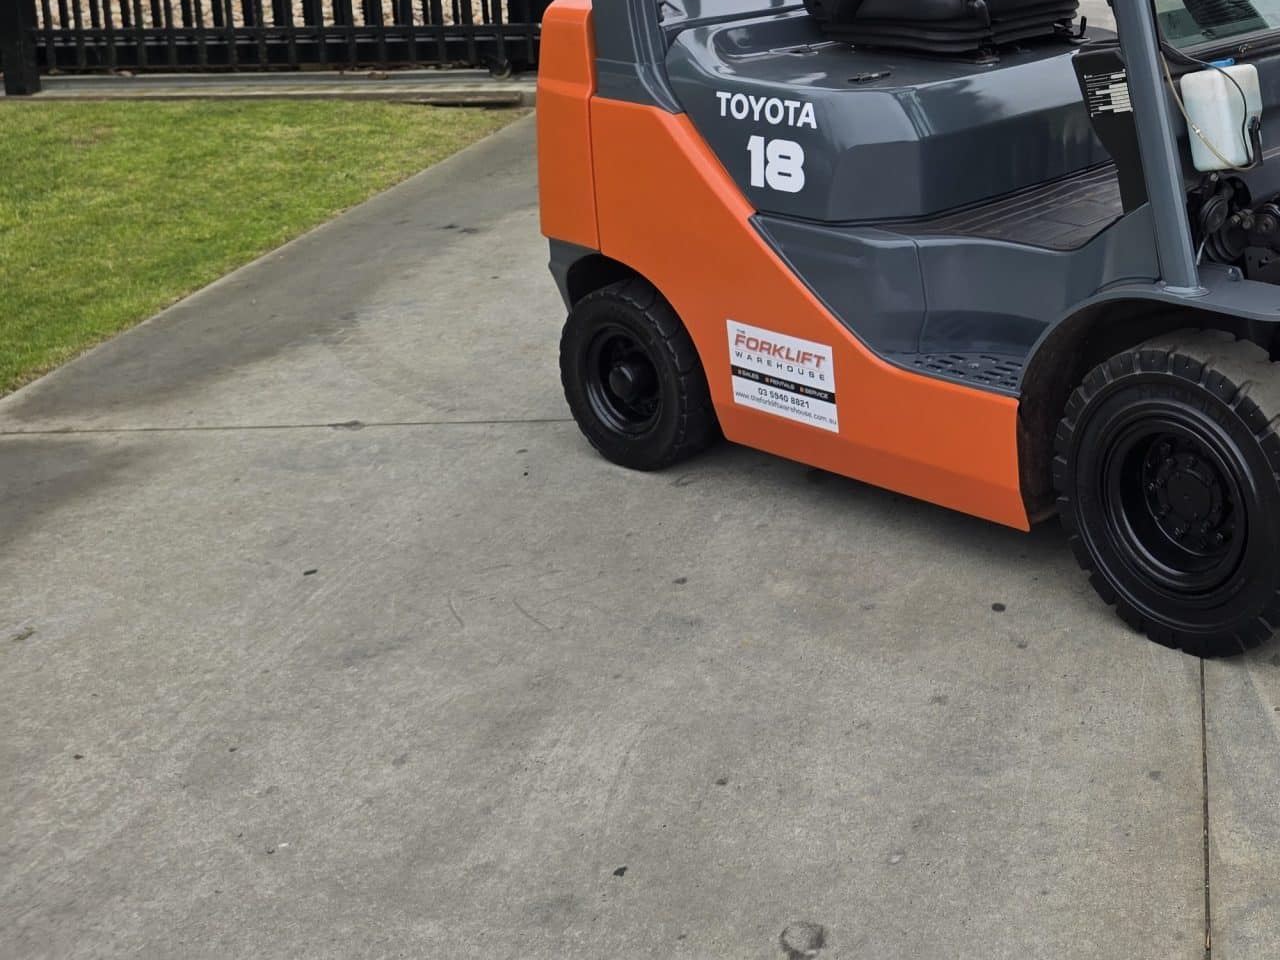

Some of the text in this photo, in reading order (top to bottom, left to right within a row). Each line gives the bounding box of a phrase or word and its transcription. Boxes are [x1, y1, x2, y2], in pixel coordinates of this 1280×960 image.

[716, 91, 818, 129] TOYOTA
[747, 135, 805, 193] 18
[734, 333, 826, 368] FORKLIFT
[735, 350, 825, 381] WAREHOUSE
